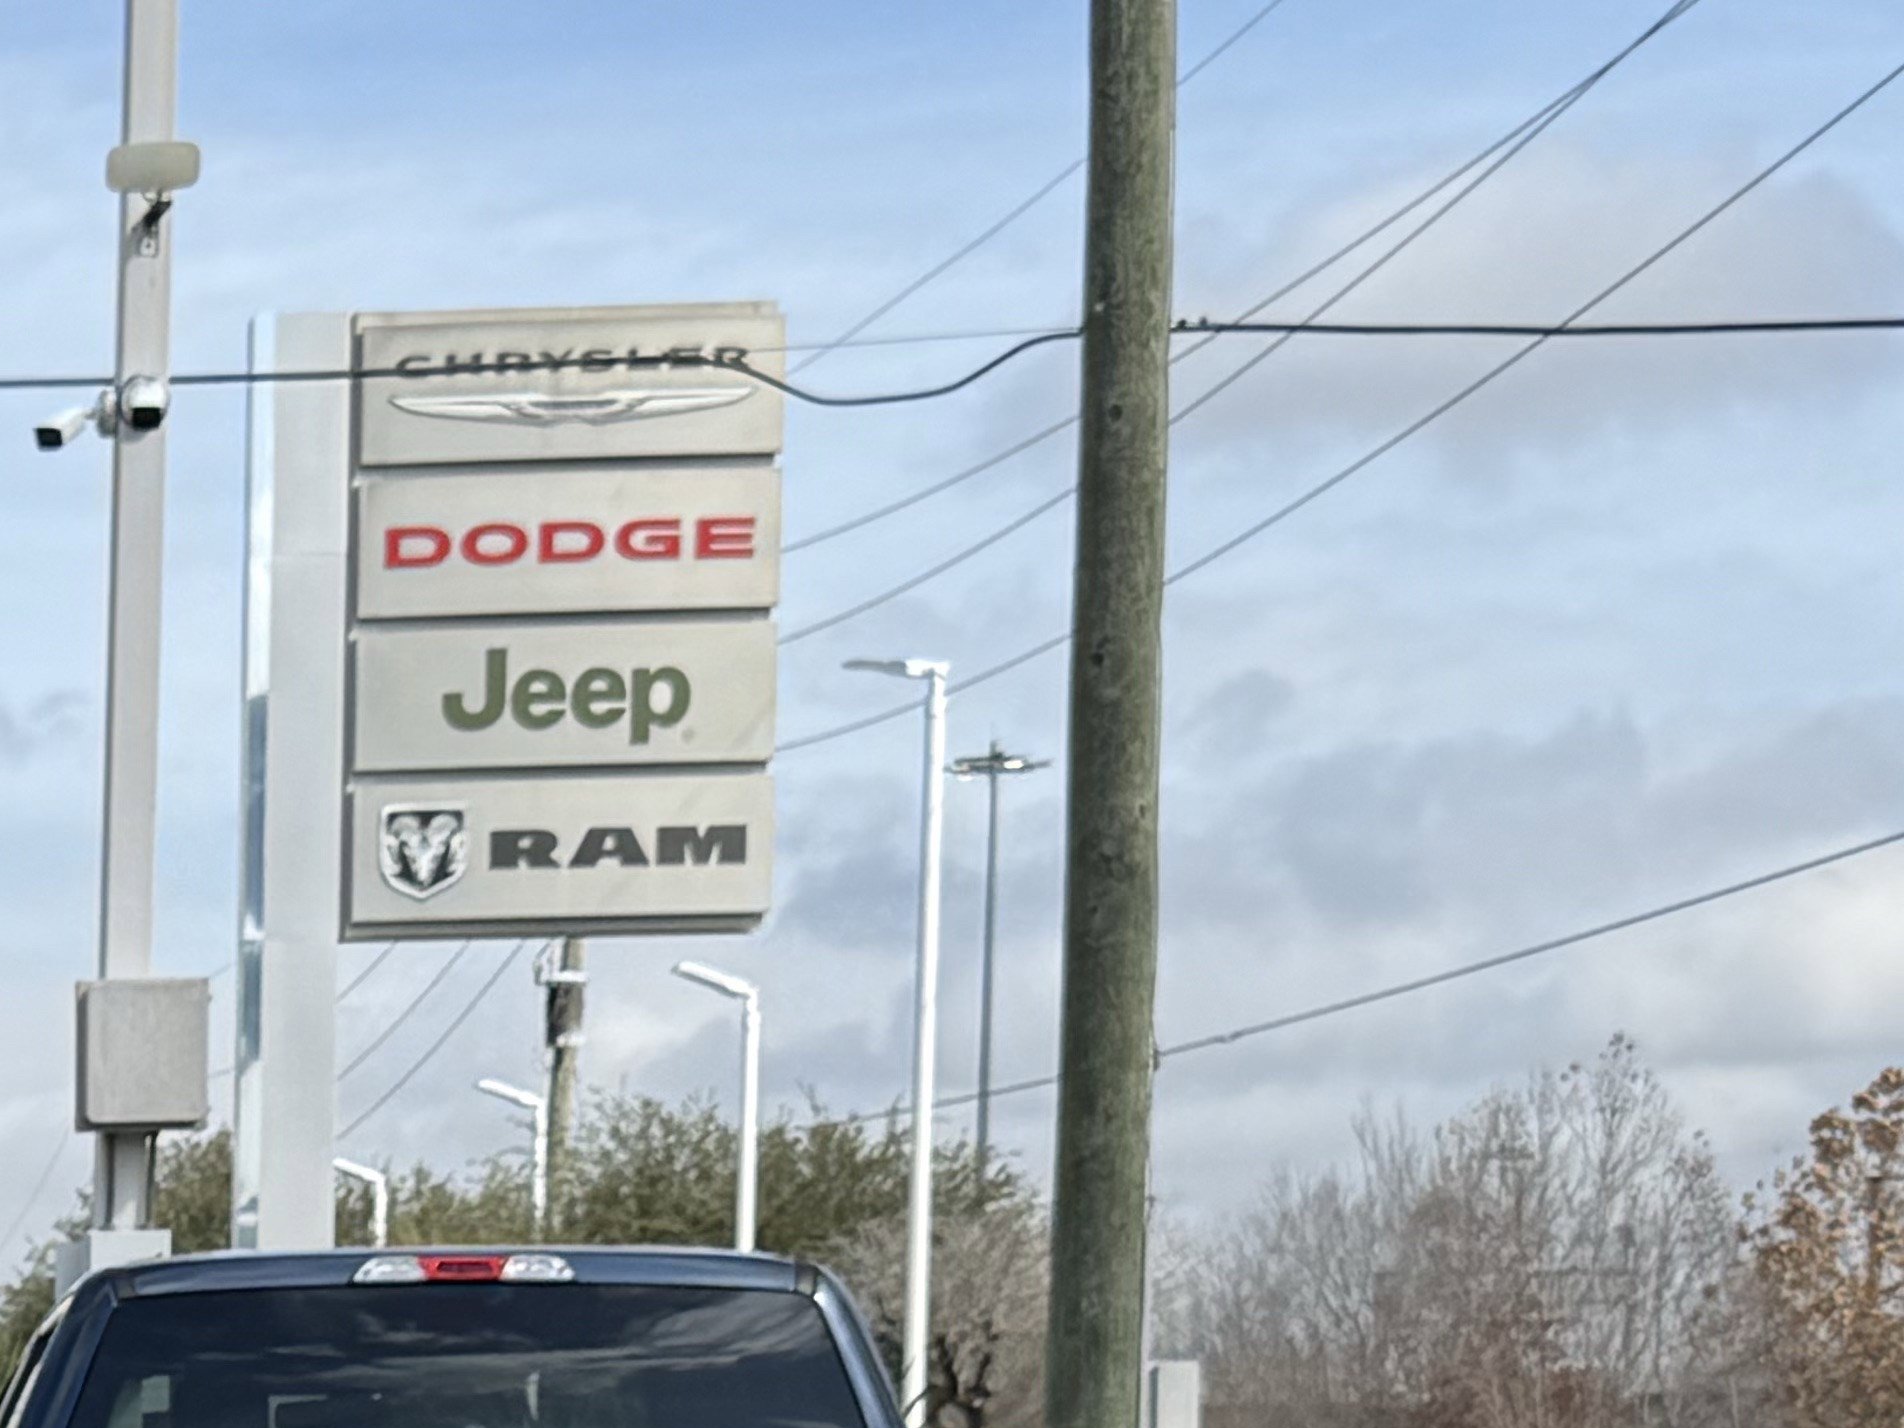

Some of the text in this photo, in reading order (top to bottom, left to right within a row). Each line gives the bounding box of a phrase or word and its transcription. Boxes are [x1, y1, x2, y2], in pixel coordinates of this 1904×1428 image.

[383, 516, 755, 570] DODGE
[442, 648, 691, 745] Jeep
[489, 824, 747, 870] RAM
